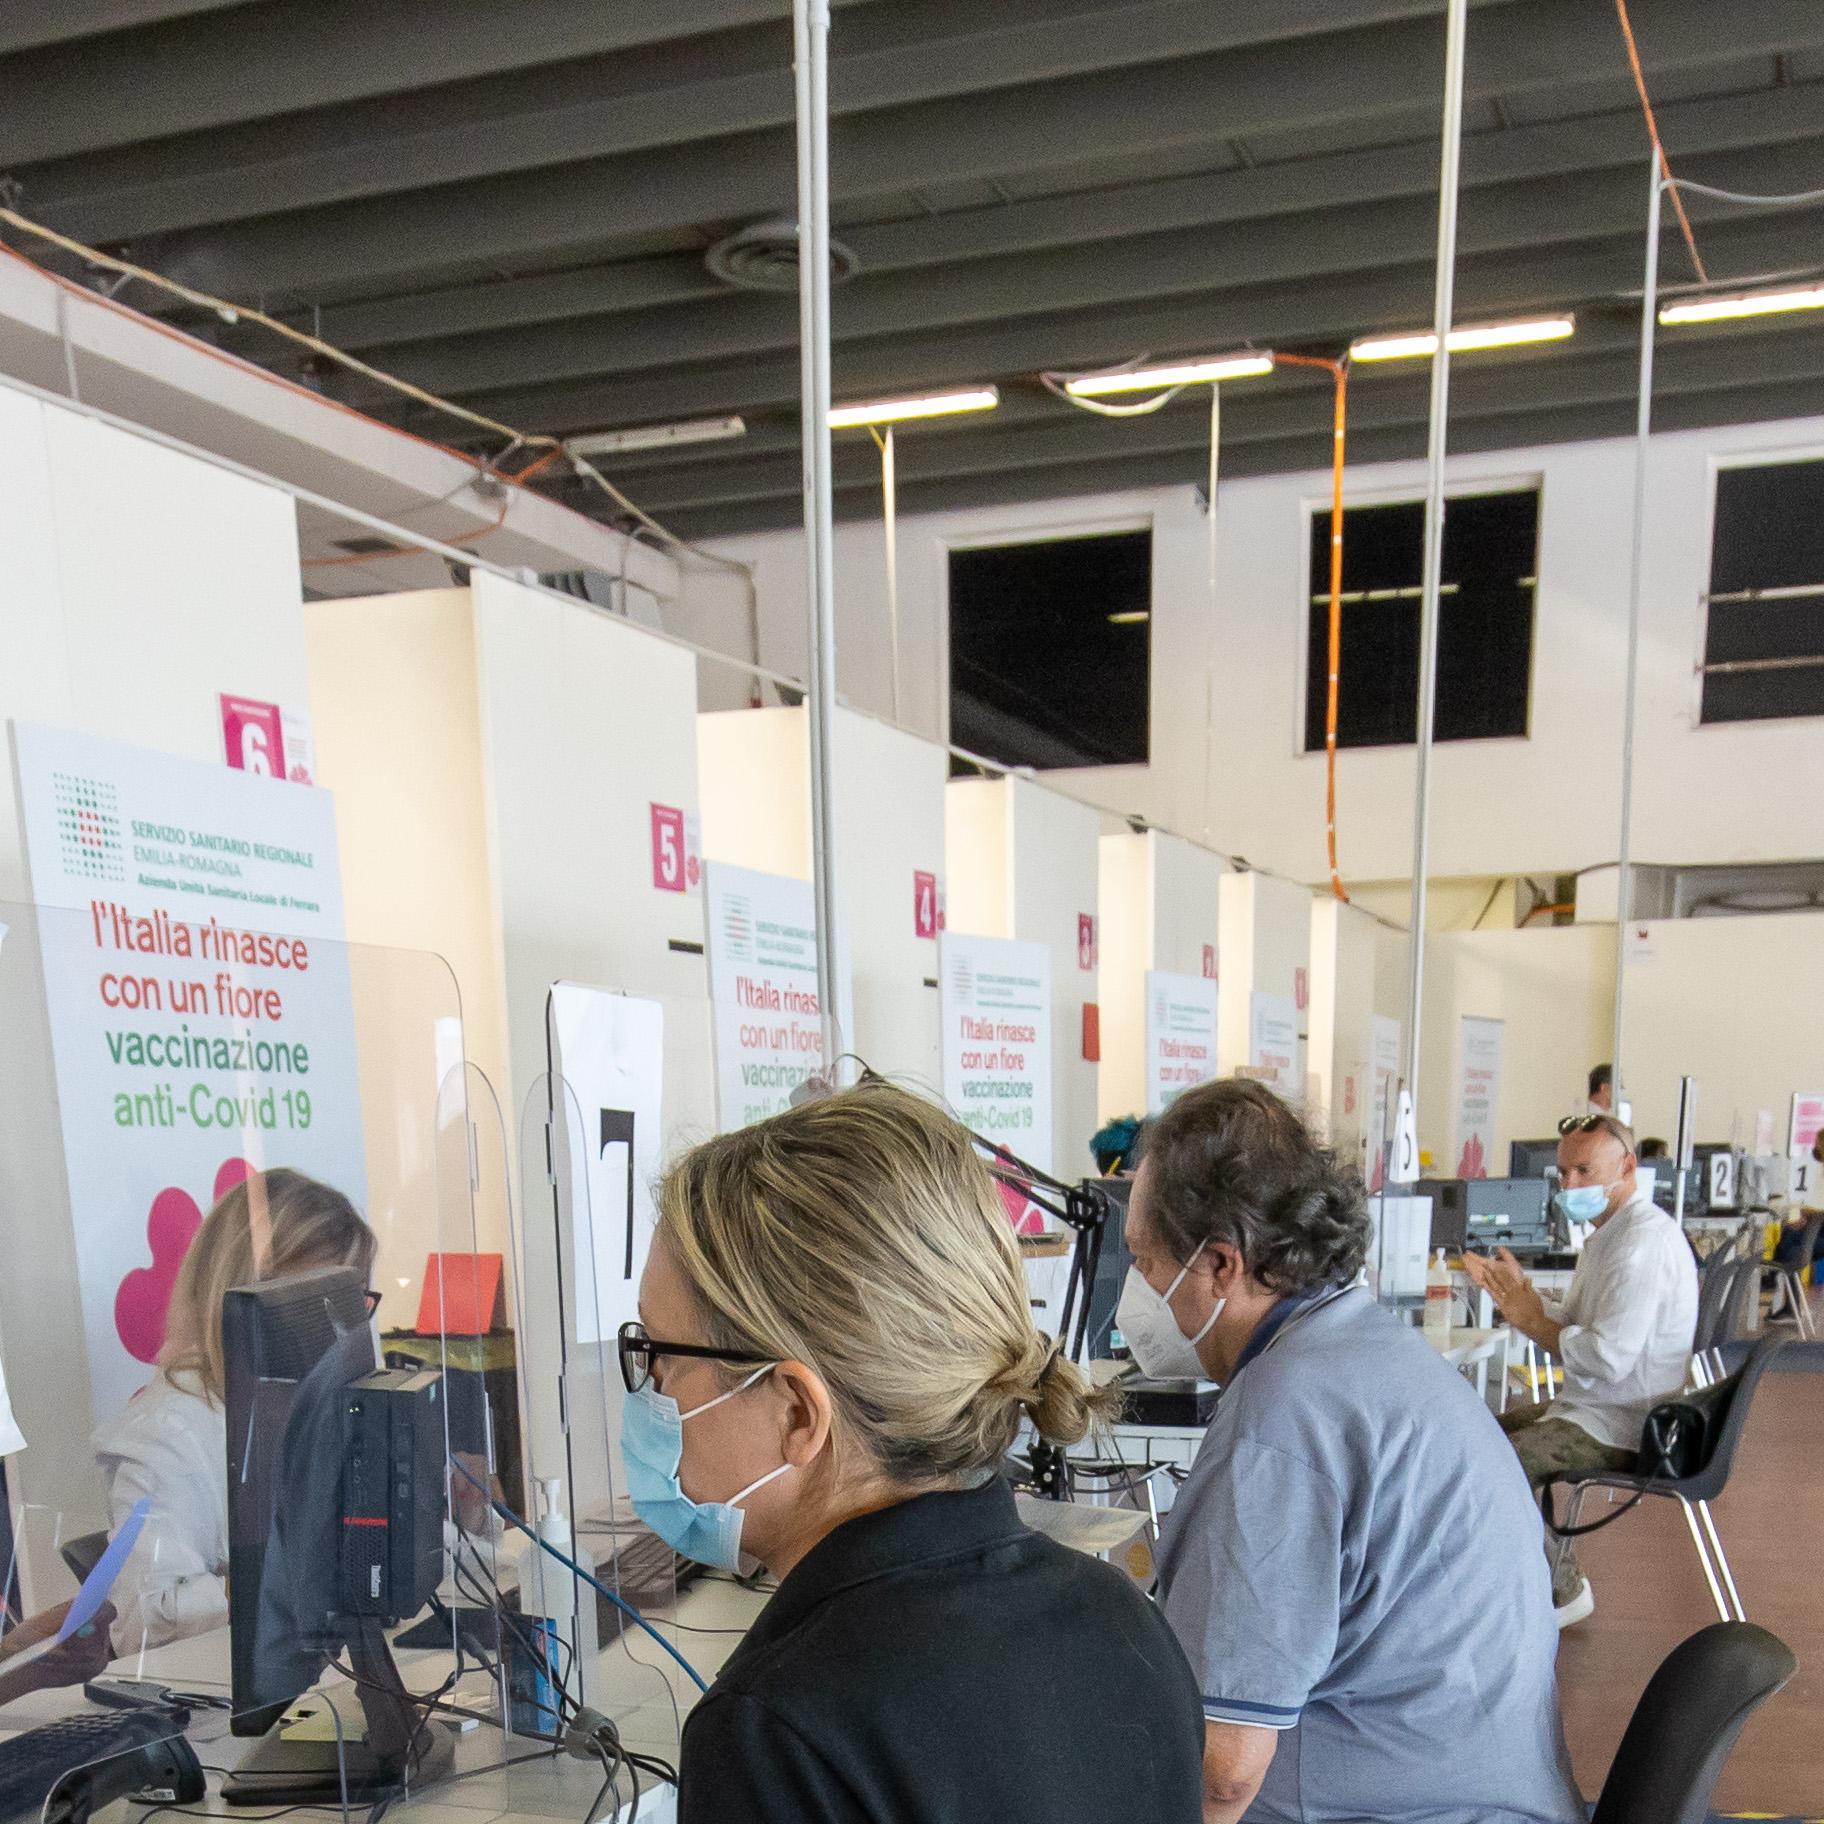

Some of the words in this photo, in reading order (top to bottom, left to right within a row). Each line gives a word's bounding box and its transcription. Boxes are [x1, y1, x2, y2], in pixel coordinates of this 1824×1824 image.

[131, 820, 186, 845] SERVIZIO
[189, 830, 251, 857] SANITARIO
[253, 842, 314, 869] REGIONALE
[133, 845, 243, 878] EMILIA-ROMAGNA
[660, 822, 678, 884] 5
[200, 915, 309, 971] rinasce
[99, 972, 162, 1010] con
[169, 979, 209, 1015] un
[215, 972, 282, 1021] fiore
[784, 983, 821, 1016] rinas
[105, 1023, 310, 1074] vaccinazione
[739, 1023, 767, 1049] con
[770, 1027, 788, 1050] un
[741, 1057, 816, 1087] vaccinazi
[113, 1082, 277, 1130] anti-Covid
[281, 1087, 312, 1129] 19
[1716, 1160, 1728, 1198] 2
[1794, 1164, 1808, 1193] 1
